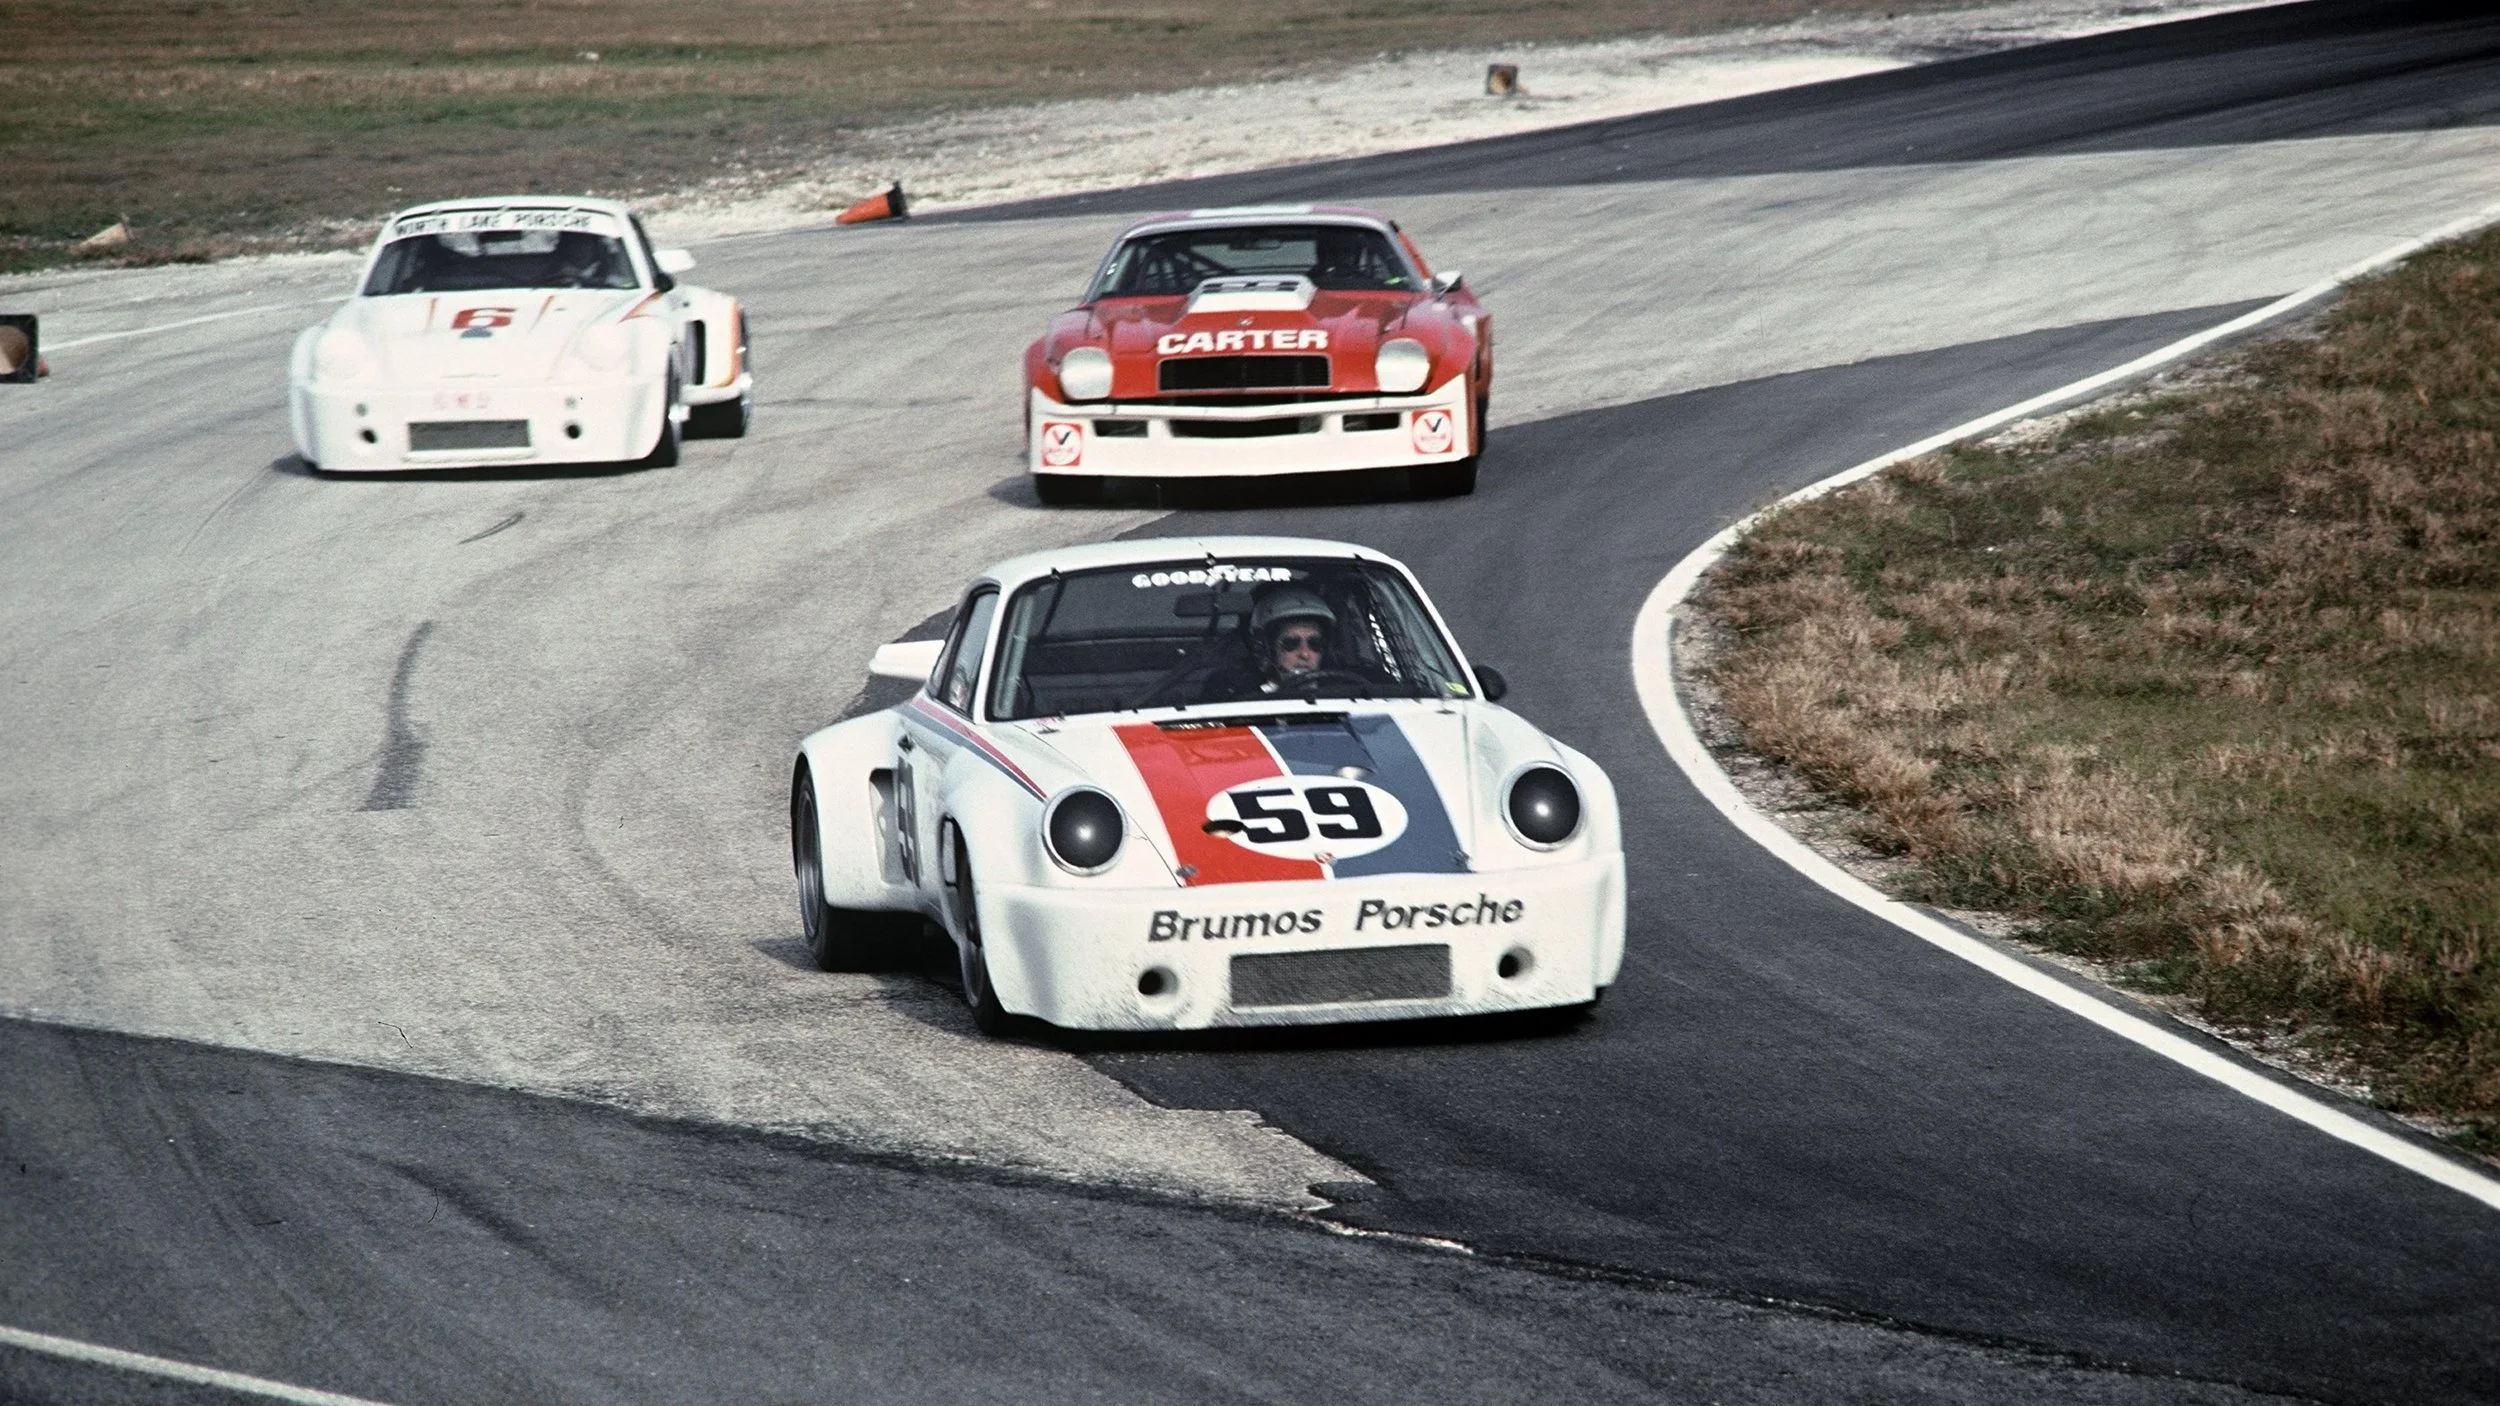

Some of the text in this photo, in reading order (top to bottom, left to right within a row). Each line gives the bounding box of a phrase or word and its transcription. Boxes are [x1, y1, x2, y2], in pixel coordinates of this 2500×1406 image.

[450, 307, 518, 330] 6
[1157, 329, 1329, 355] CARTER
[1131, 565, 1292, 588] GOODYEAR
[1227, 786, 1383, 844] 59
[1147, 892, 1524, 943] Brumos Porsche
